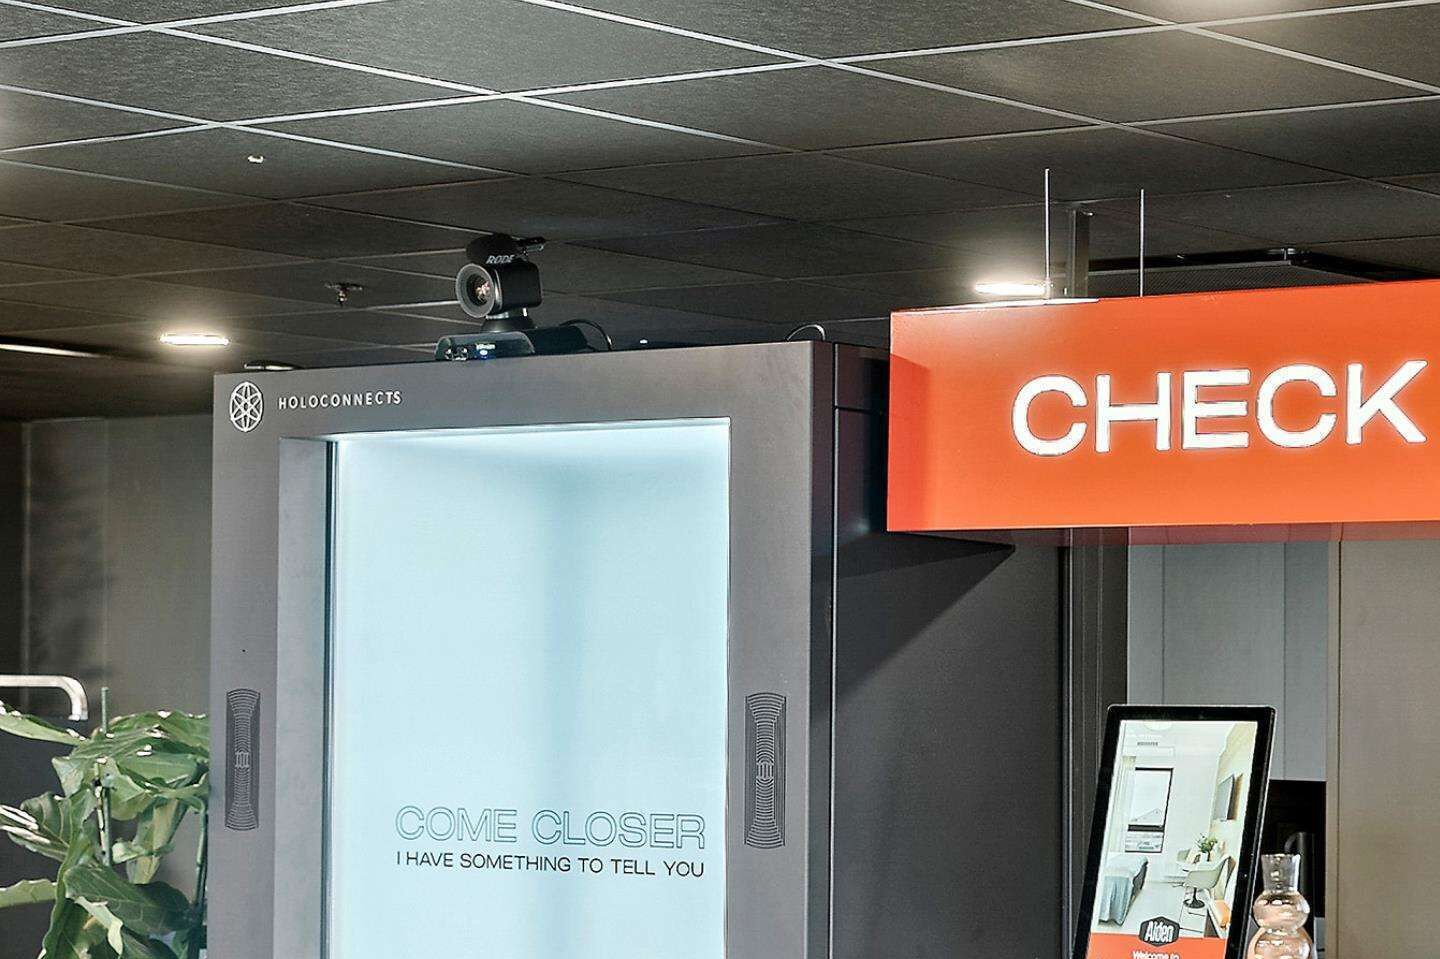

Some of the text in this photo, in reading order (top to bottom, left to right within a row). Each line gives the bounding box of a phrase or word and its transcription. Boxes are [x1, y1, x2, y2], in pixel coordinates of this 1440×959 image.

[278, 390, 402, 410] HOLOCONNECTS
[1011, 359, 1427, 457] CHECK
[395, 805, 706, 850] COME CLOSER
[396, 851, 705, 878] I HAVE SOMETHING TO TELL YOU
[1144, 920, 1175, 943] Aiden
